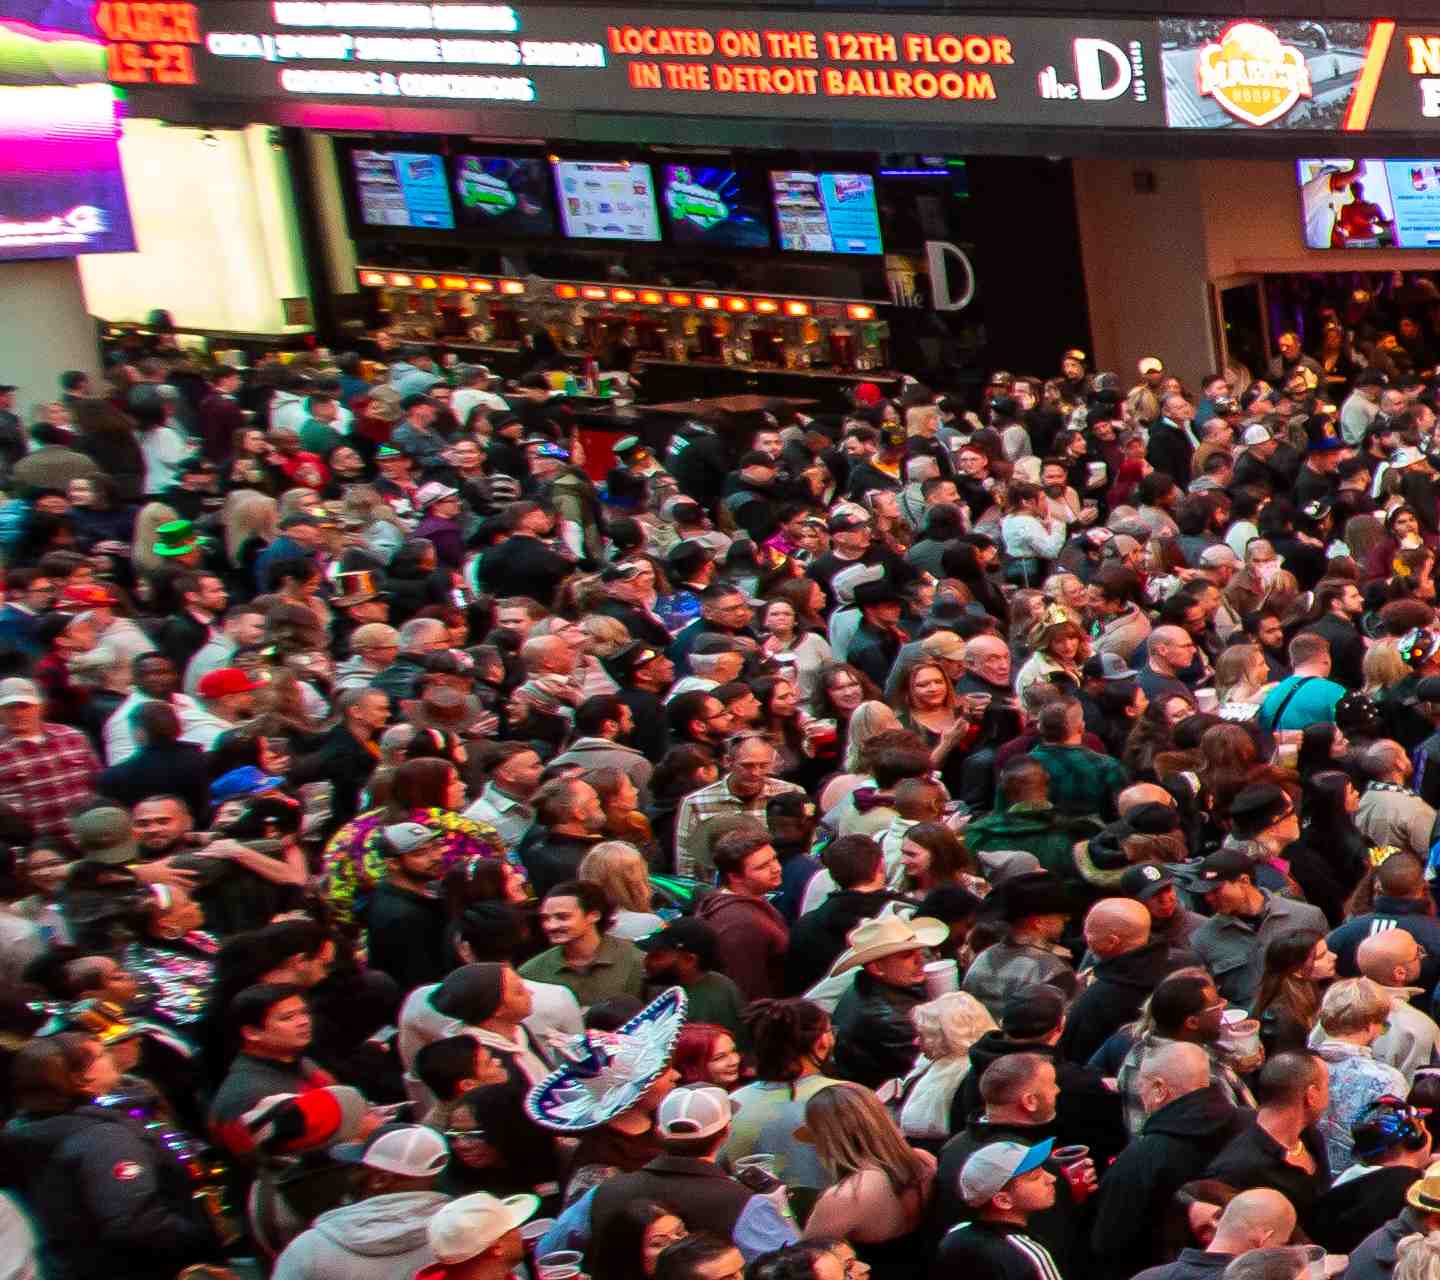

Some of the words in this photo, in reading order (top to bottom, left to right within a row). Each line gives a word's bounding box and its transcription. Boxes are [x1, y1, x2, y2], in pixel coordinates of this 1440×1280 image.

[608, 24, 714, 56] LOCATED
[717, 28, 762, 58] ON
[763, 29, 819, 60] THE
[823, 31, 898, 62] 12TH
[903, 32, 1015, 65] FLOOR
[1074, 37, 1131, 100] D
[628, 61, 662, 89] IN
[662, 62, 711, 91] THE
[711, 63, 818, 96] DETROIT
[822, 65, 997, 101] BALLROOM
[926, 240, 976, 312] D
